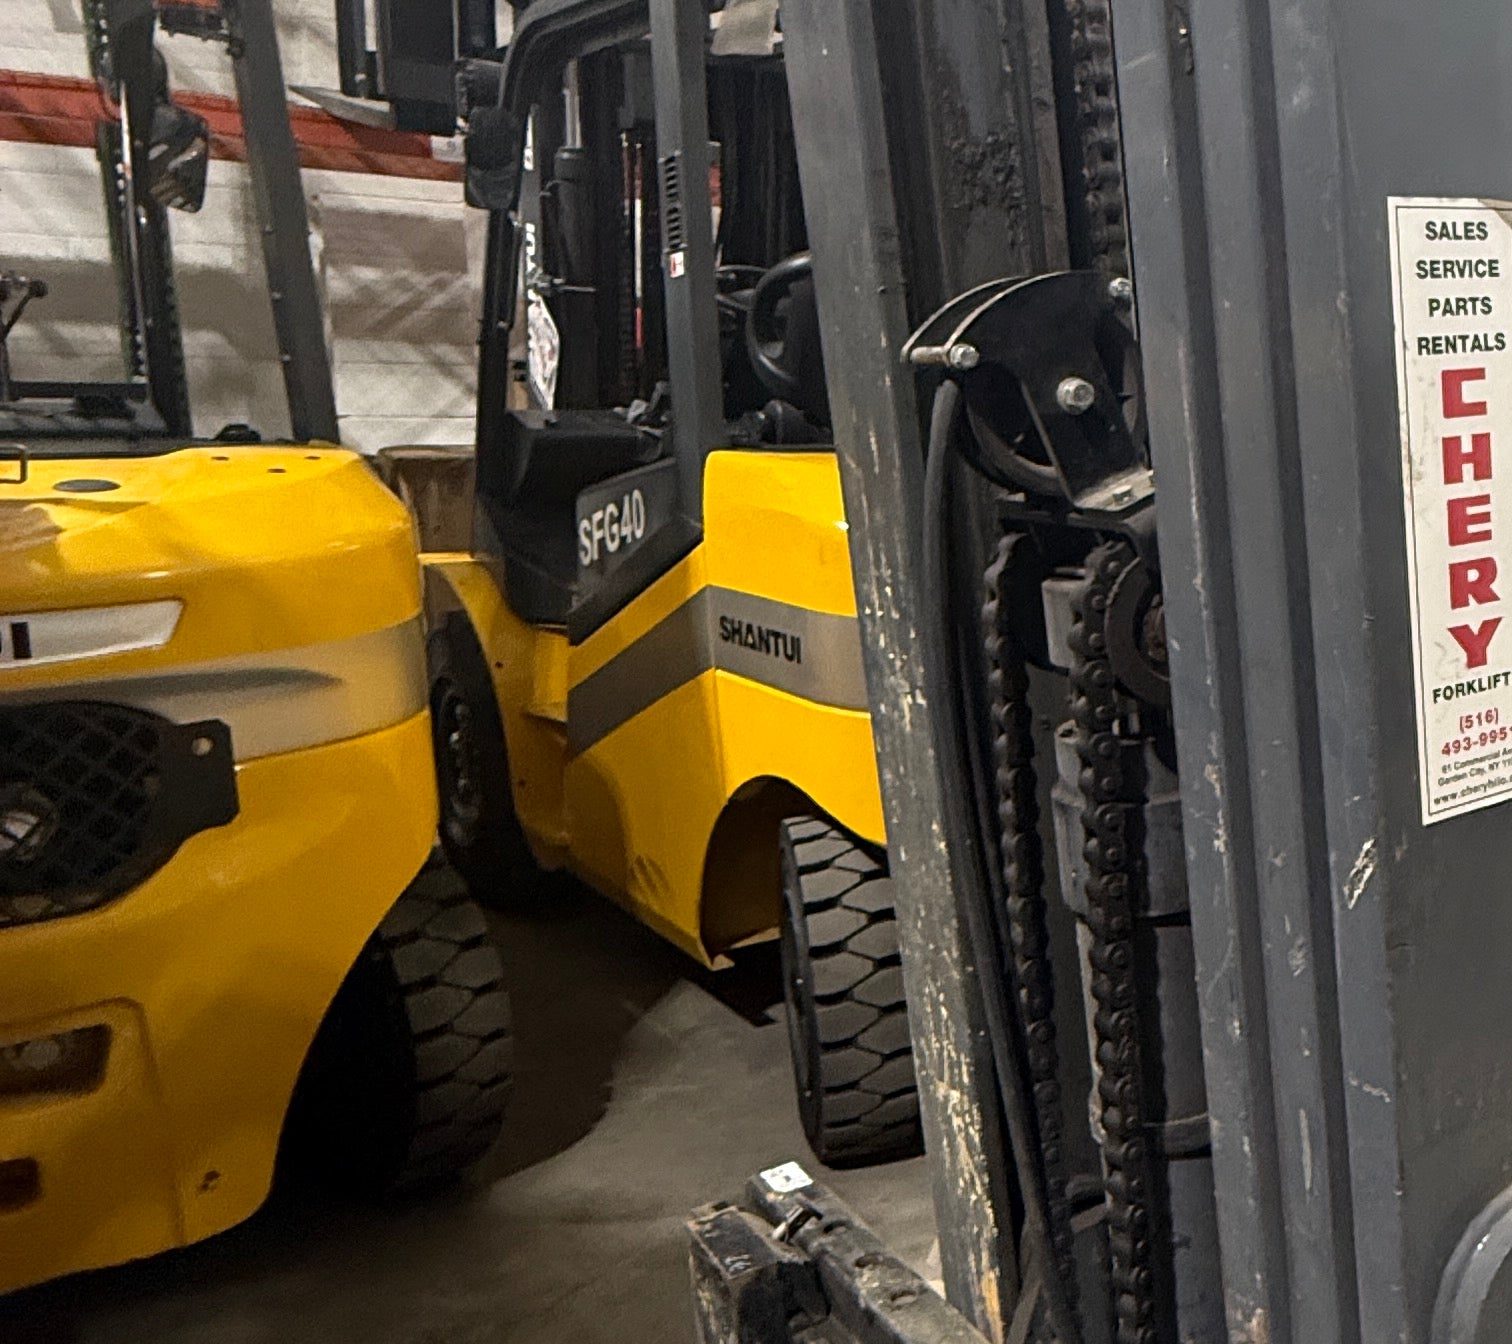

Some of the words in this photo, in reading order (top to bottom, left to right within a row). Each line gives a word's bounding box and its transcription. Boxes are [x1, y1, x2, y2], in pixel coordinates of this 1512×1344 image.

[1425, 220, 1489, 241] SALES
[1415, 258, 1500, 280] SERVICE
[1427, 296, 1493, 318] PARTS
[1417, 332, 1507, 356] RENTALS
[578, 488, 645, 567] SFG40
[1440, 367, 1503, 669] CHERY
[718, 615, 802, 664] SHANTUI
[1459, 707, 1499, 734] (516)
